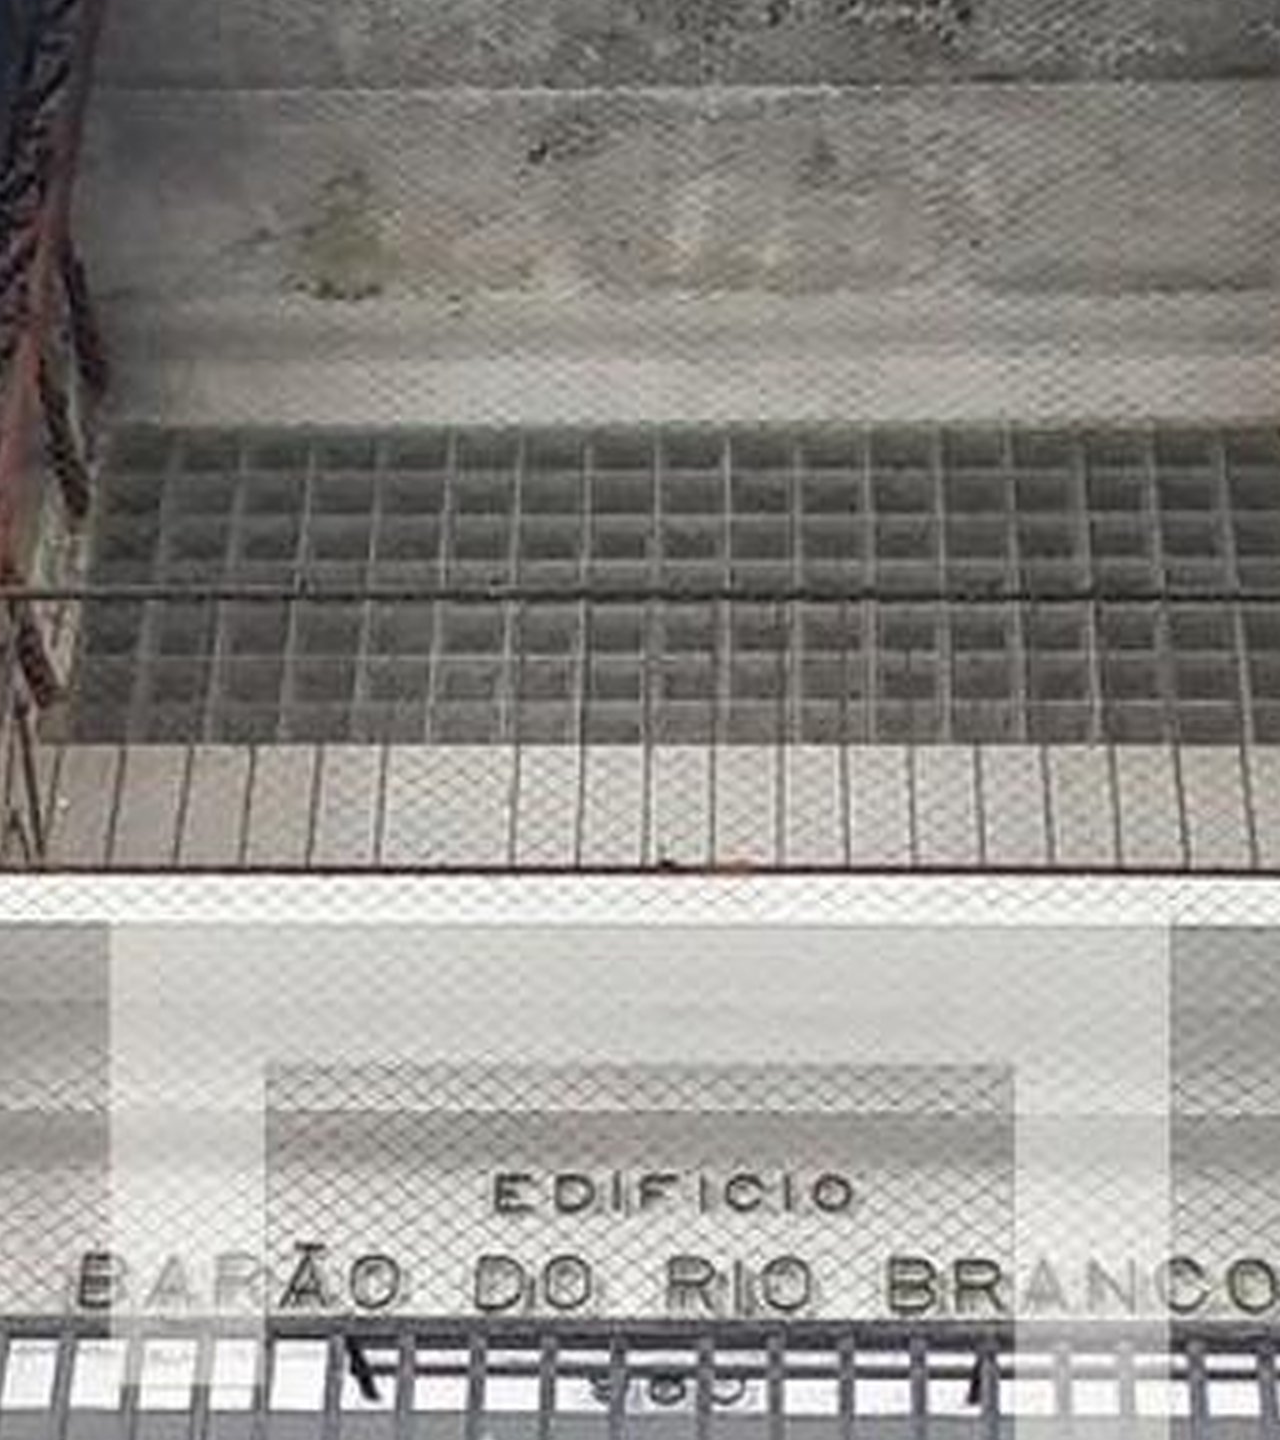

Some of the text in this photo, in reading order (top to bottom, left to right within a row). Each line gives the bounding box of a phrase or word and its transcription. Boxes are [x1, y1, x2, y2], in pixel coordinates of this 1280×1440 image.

[492, 1172, 855, 1216] EDIFICIO
[77, 1241, 402, 1311] BARÃO
[473, 1254, 594, 1312] DO
[665, 1255, 814, 1314] RIO
